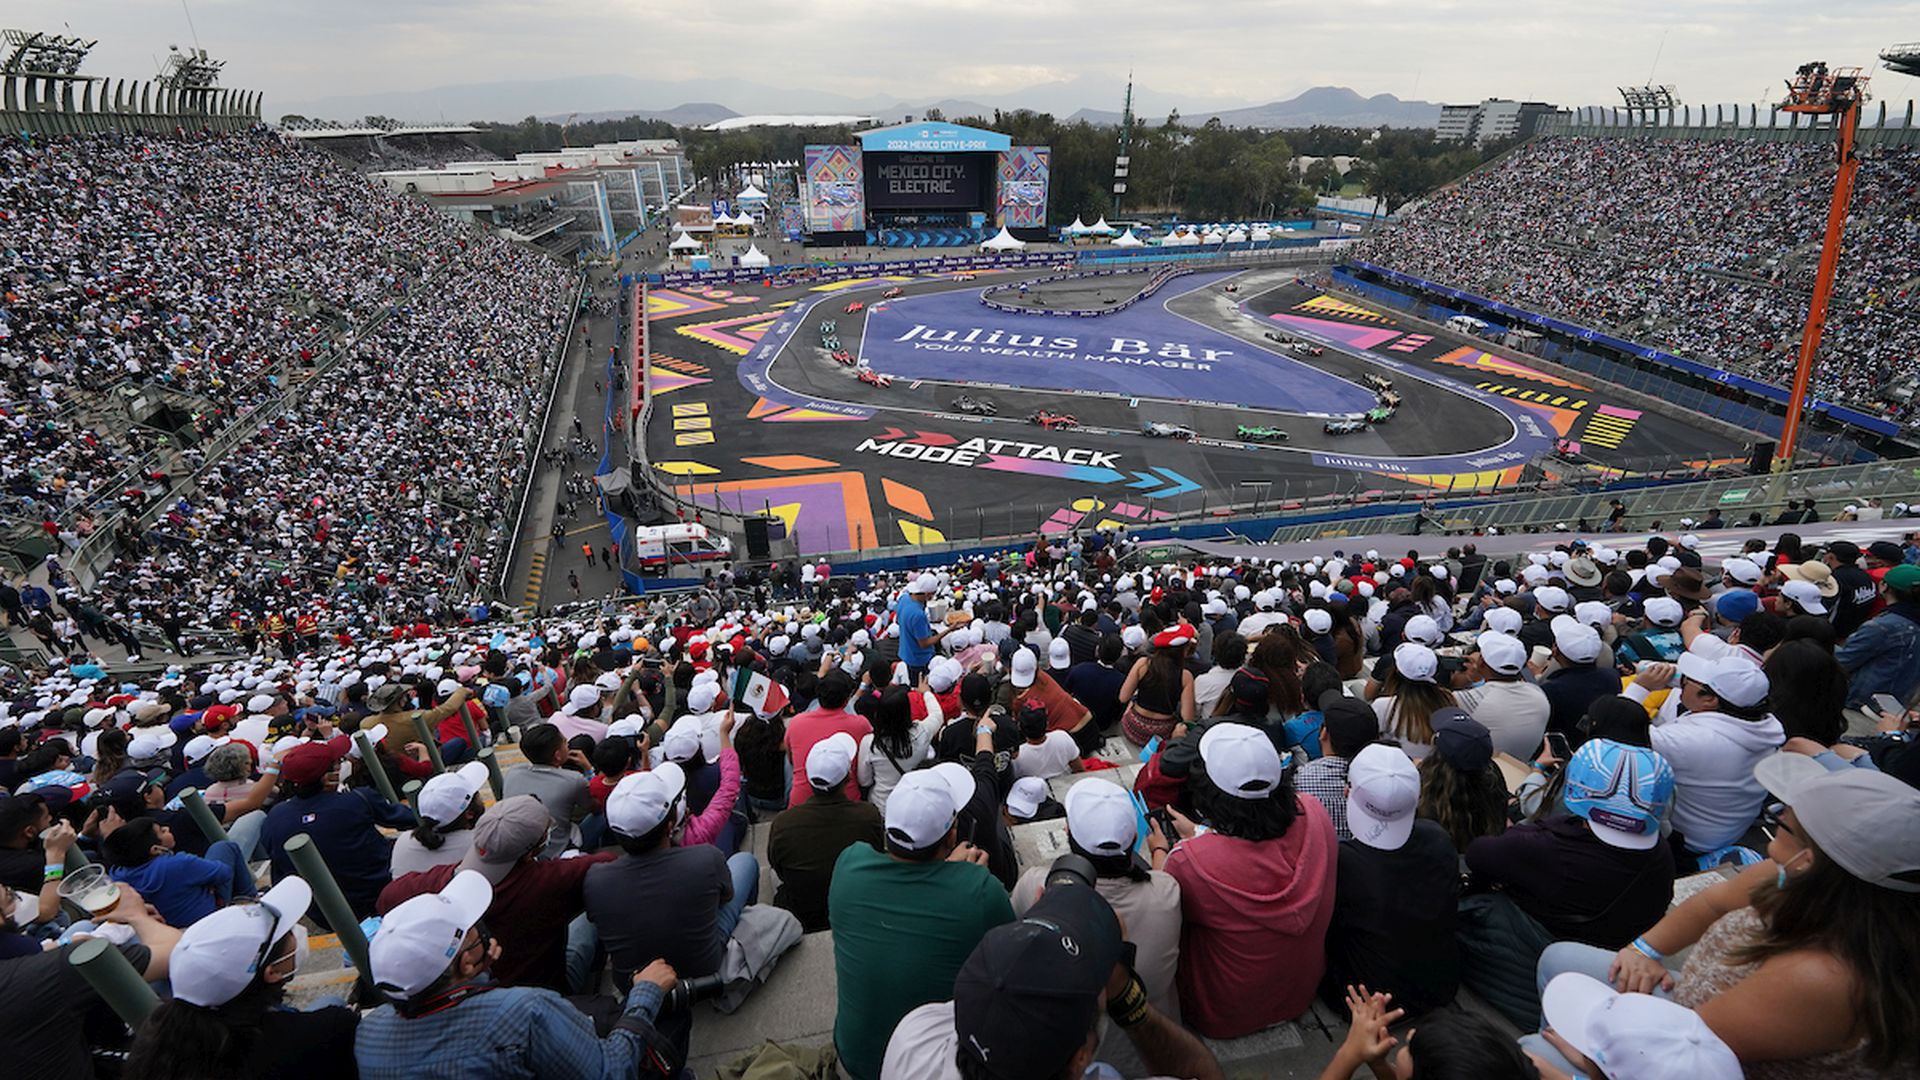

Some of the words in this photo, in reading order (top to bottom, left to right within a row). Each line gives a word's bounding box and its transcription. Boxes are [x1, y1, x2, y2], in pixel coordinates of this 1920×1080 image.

[887, 140, 908, 149] 2022
[909, 140, 939, 149] MEXICO
[940, 140, 959, 149] CITY
[960, 140, 987, 149] E-PRIX
[878, 165, 929, 178] MEXICO
[932, 165, 966, 178] CITY.
[889, 180, 955, 193] ELECTRIC.
[894, 324, 1078, 349] Julius
[1106, 337, 1234, 362] Bär
[914, 342, 972, 353] YOUR
[980, 347, 1075, 360] WEALTH
[1085, 354, 1212, 371] MANAGER
[854, 438, 981, 468] MODE
[957, 437, 1122, 469] ATTACK
[1325, 457, 1373, 468] Julius
[1377, 462, 1409, 472] Bär
